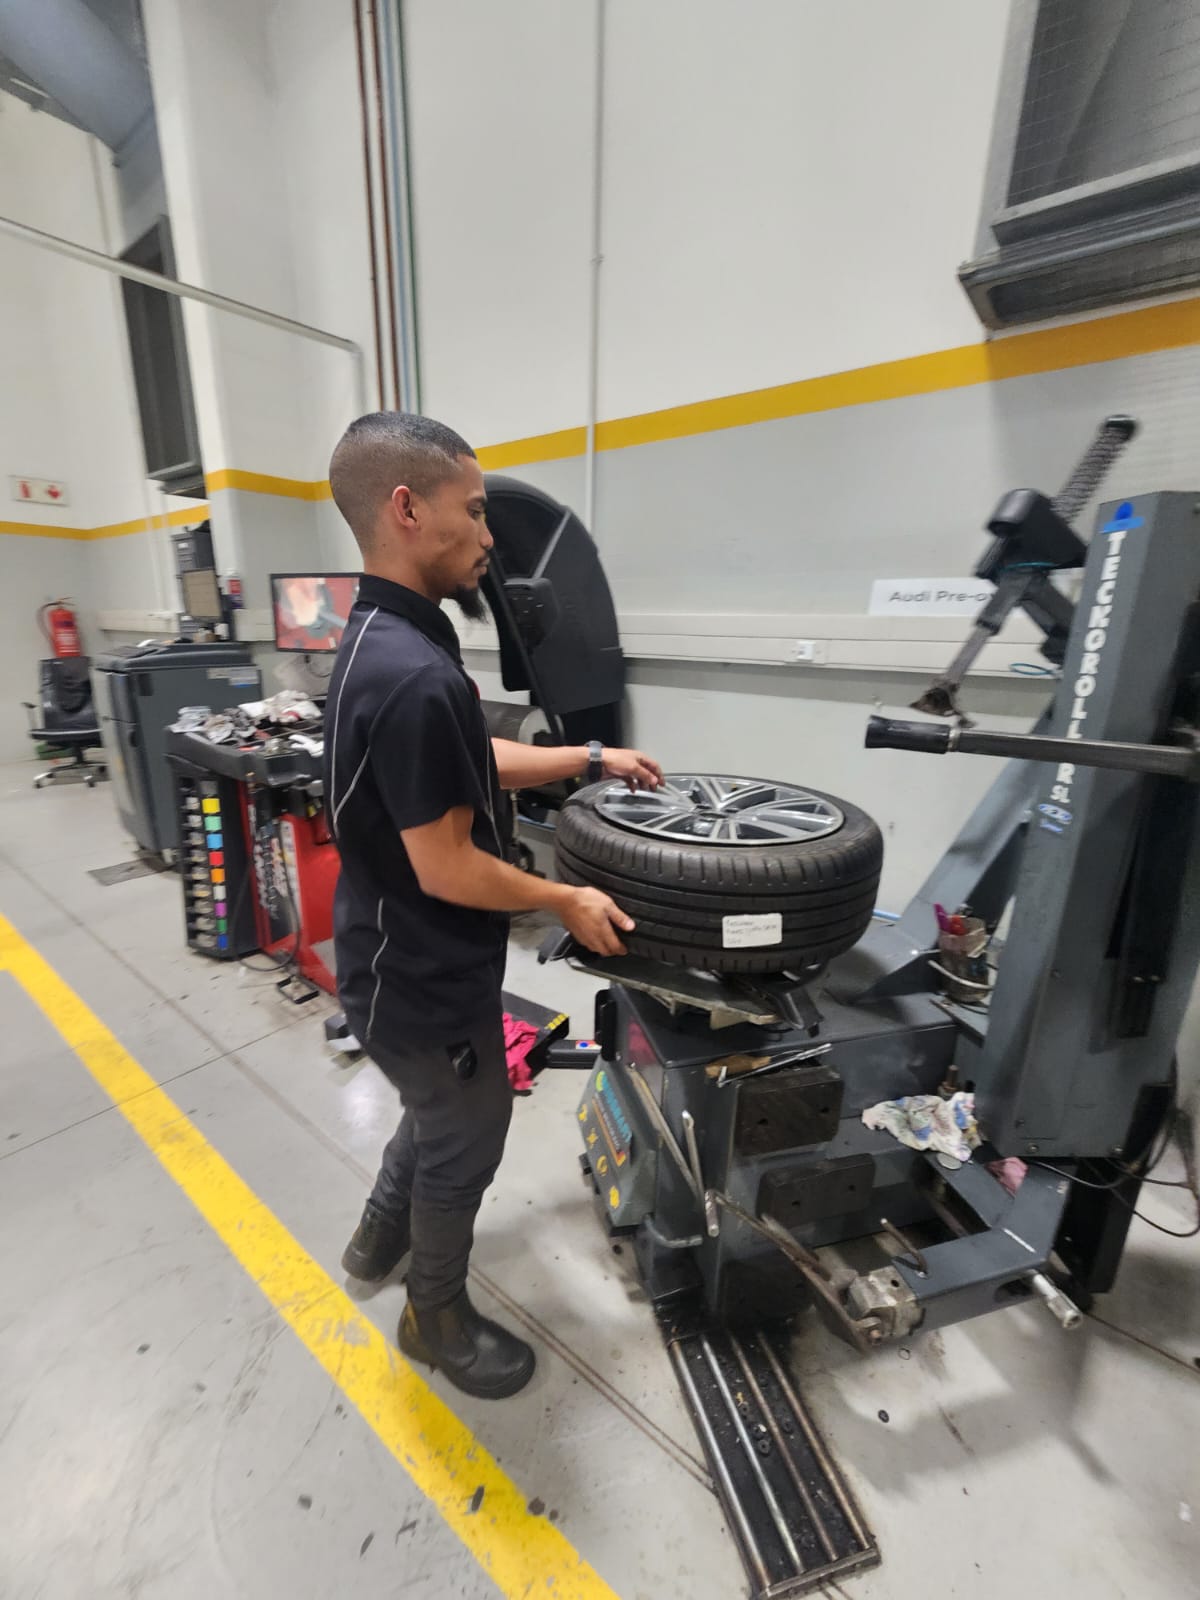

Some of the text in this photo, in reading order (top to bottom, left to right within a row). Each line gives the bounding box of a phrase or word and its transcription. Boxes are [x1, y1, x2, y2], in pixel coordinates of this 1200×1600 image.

[888, 590, 989, 602] Audi Pre-o
[1056, 531, 1127, 784] TECKOROLLR
